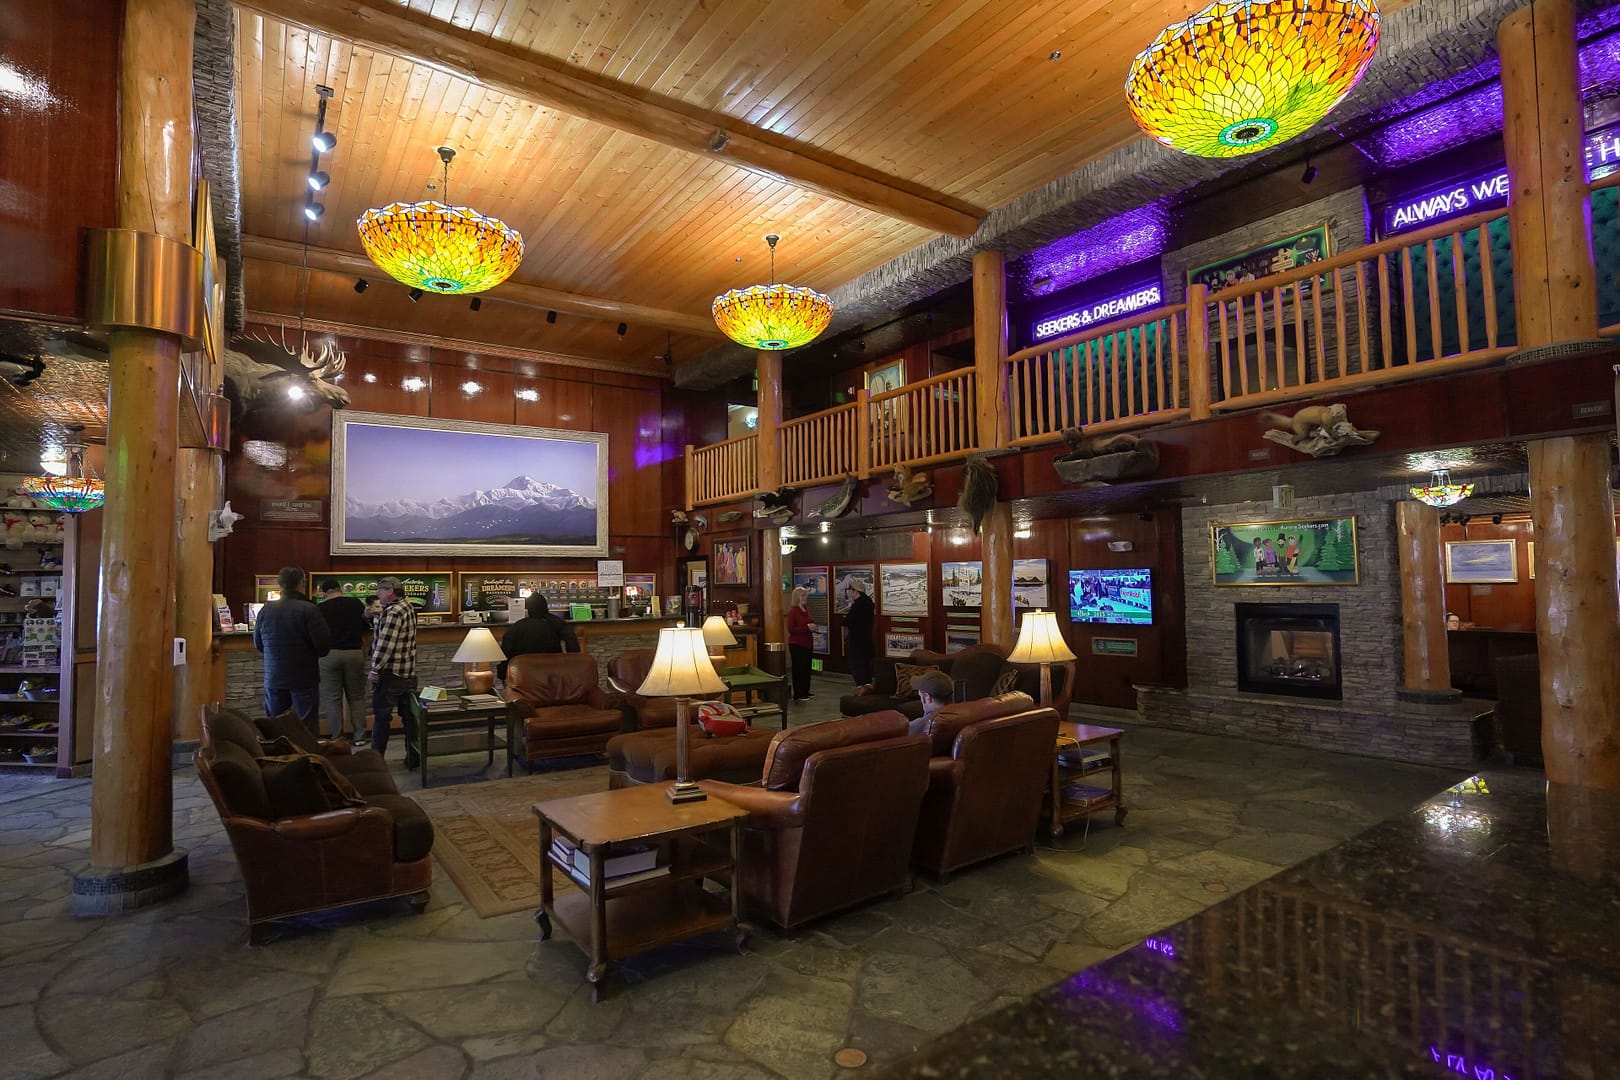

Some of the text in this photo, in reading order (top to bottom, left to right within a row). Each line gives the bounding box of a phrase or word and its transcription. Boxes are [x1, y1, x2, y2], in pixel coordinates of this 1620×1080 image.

[1393, 174, 1509, 227] ALWAYS WE
[1036, 287, 1160, 337] SEEKERS & DREAMERS
